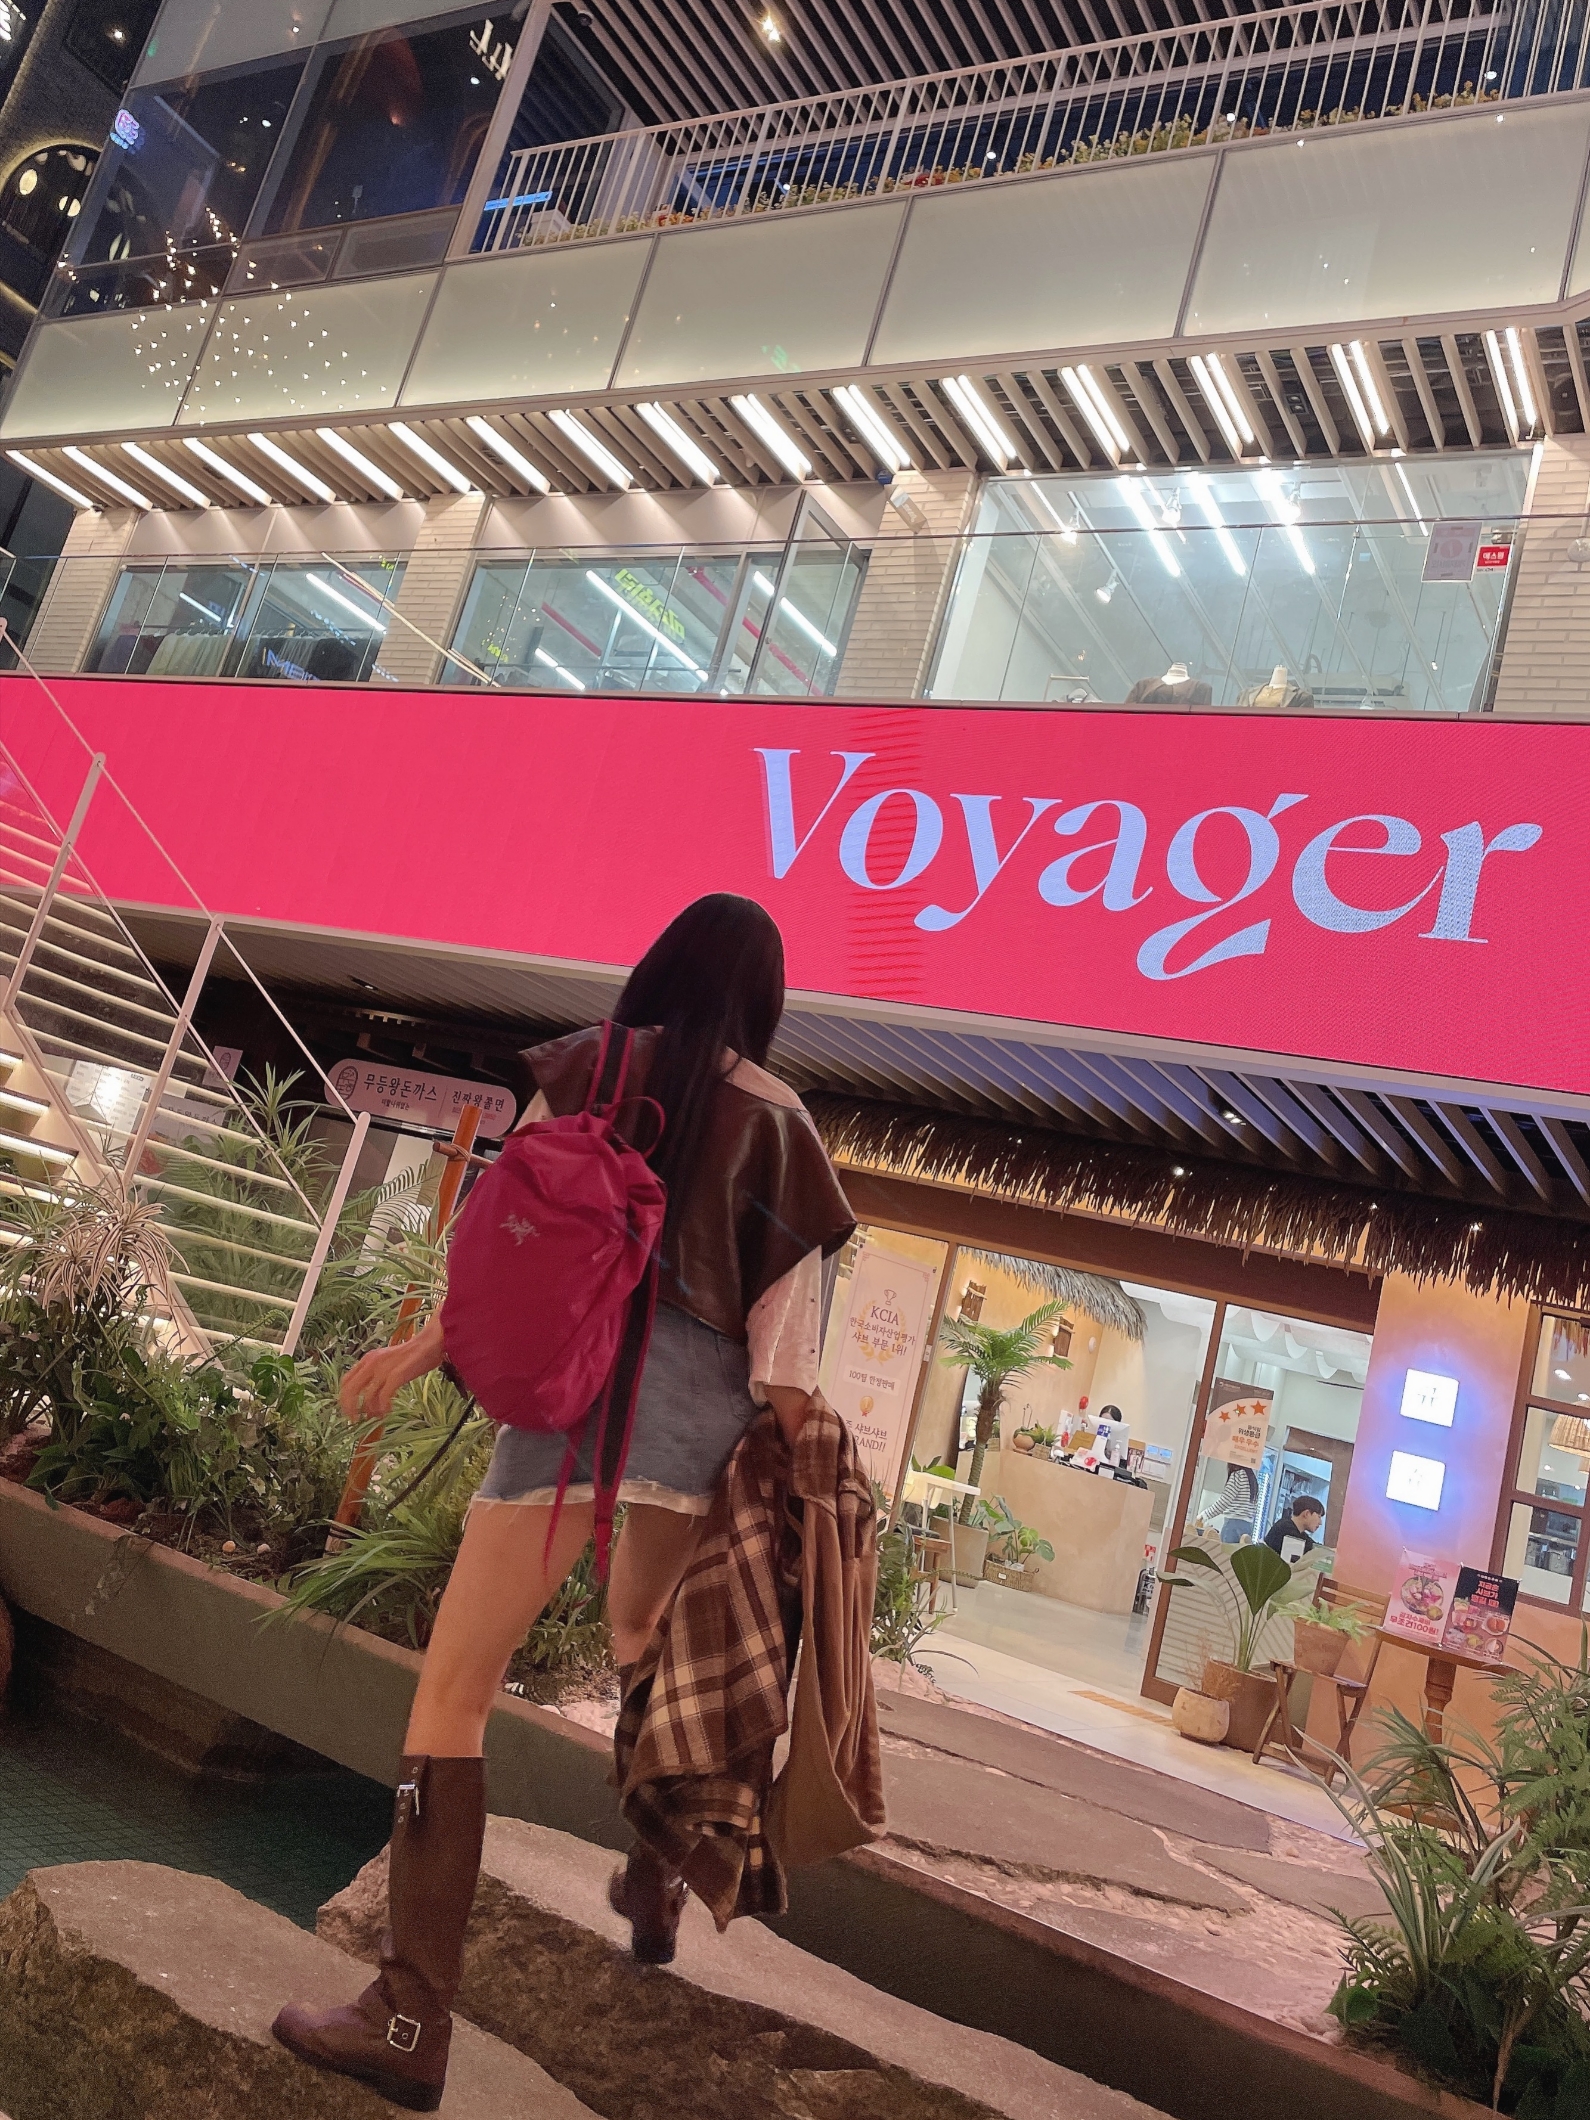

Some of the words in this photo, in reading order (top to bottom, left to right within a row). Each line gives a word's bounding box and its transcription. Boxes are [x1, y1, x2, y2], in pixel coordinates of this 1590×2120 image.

[753, 747, 1544, 981] Voyager
[363, 1073, 437, 1102] 무등왕돈까스
[870, 1305, 899, 1326] KCIA
[849, 1316, 916, 1346] 한국소비자산업평가
[851, 1331, 869, 1345] 샤브
[872, 1336, 889, 1351] 부문
[891, 1343, 907, 1356] 1위!
[855, 1422, 887, 1440] 샤브샤브
[854, 1435, 886, 1453] RAND!!
